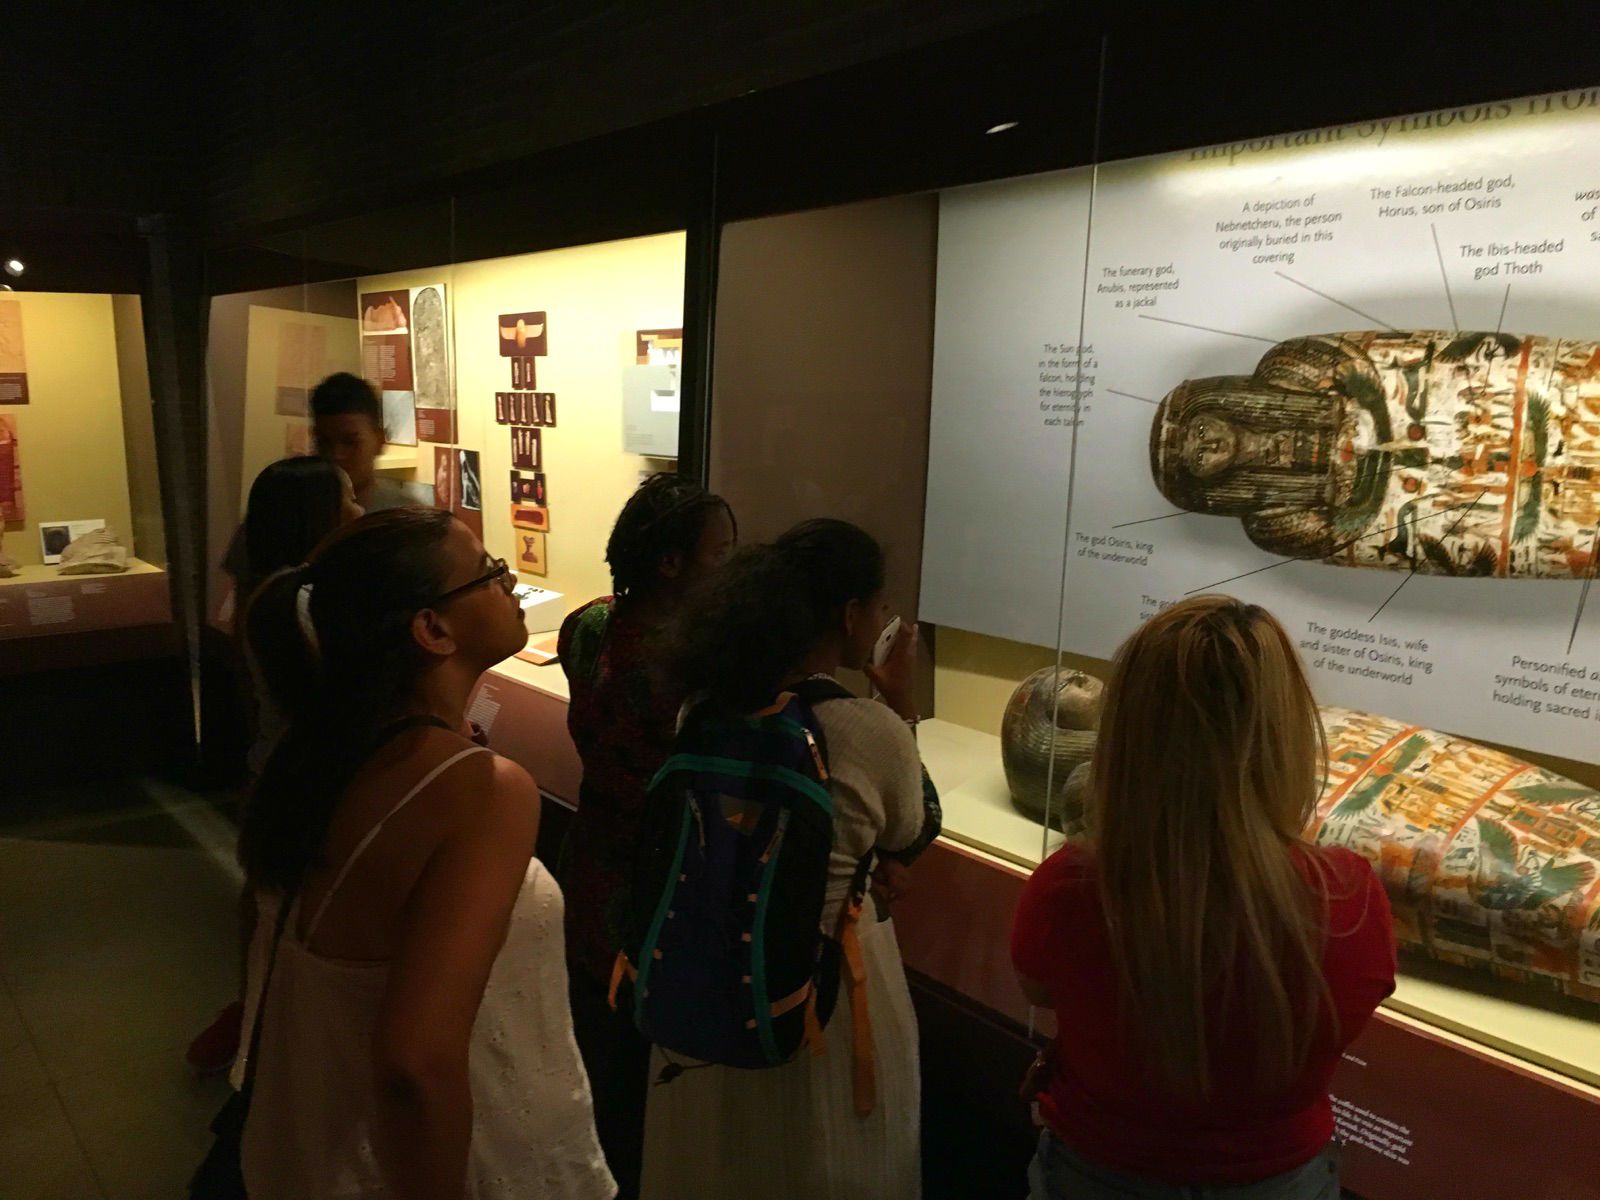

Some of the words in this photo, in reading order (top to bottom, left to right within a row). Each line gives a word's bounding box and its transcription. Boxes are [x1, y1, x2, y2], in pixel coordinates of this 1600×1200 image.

[1370, 187, 1391, 200] The
[1395, 177, 1483, 198] Falcon-headed
[1486, 174, 1516, 192] god,
[1242, 202, 1250, 212] A
[1253, 198, 1300, 213] depiction
[1303, 193, 1316, 207] of
[1378, 205, 1418, 218] Horus,
[1422, 202, 1444, 214] son
[1448, 198, 1463, 212] of
[1464, 196, 1502, 211] Osiris
[1285, 215, 1301, 226] the
[1304, 212, 1342, 228] person
[1581, 206, 1597, 221] of
[1220, 235, 1262, 252] originally
[1266, 233, 1298, 246] buried
[1301, 232, 1310, 242] in
[1314, 230, 1333, 242] this
[1460, 244, 1483, 258] The
[1487, 238, 1564, 256] Ibis-headed
[1252, 251, 1294, 264] covering
[1102, 267, 1117, 278] The
[1120, 265, 1153, 277] funerary
[1474, 263, 1500, 280] god
[1503, 260, 1542, 276] Thoth
[1128, 278, 1180, 293] represented
[1115, 300, 1124, 308] as
[1126, 300, 1130, 308] a
[1133, 296, 1157, 309] jackal
[1044, 344, 1058, 354] The
[1060, 344, 1074, 354] Sun
[1048, 359, 1059, 368] the
[1084, 358, 1092, 368] of
[1076, 532, 1089, 542] The
[1091, 536, 1106, 546] god
[1136, 541, 1154, 554] king
[1078, 547, 1087, 556] of
[1088, 549, 1100, 559] the
[1102, 553, 1148, 566] underworld
[1142, 595, 1157, 606] The
[1308, 622, 1326, 634] The
[1330, 627, 1374, 643] goddess
[1379, 634, 1400, 648] Isis,
[1404, 638, 1428, 652] wife
[1300, 640, 1318, 650] and
[1322, 643, 1350, 656] sister
[1354, 648, 1366, 658] of
[1368, 650, 1404, 667] Osiris,
[1408, 656, 1432, 674] king
[1512, 656, 1586, 678] Personified
[1314, 658, 1326, 668] of
[1328, 660, 1344, 672] the
[1348, 666, 1412, 686] underworld
[1495, 674, 1548, 692] symbols
[1554, 682, 1569, 694] of
[1493, 689, 1542, 713] holding
[1546, 702, 1590, 719] sacred
